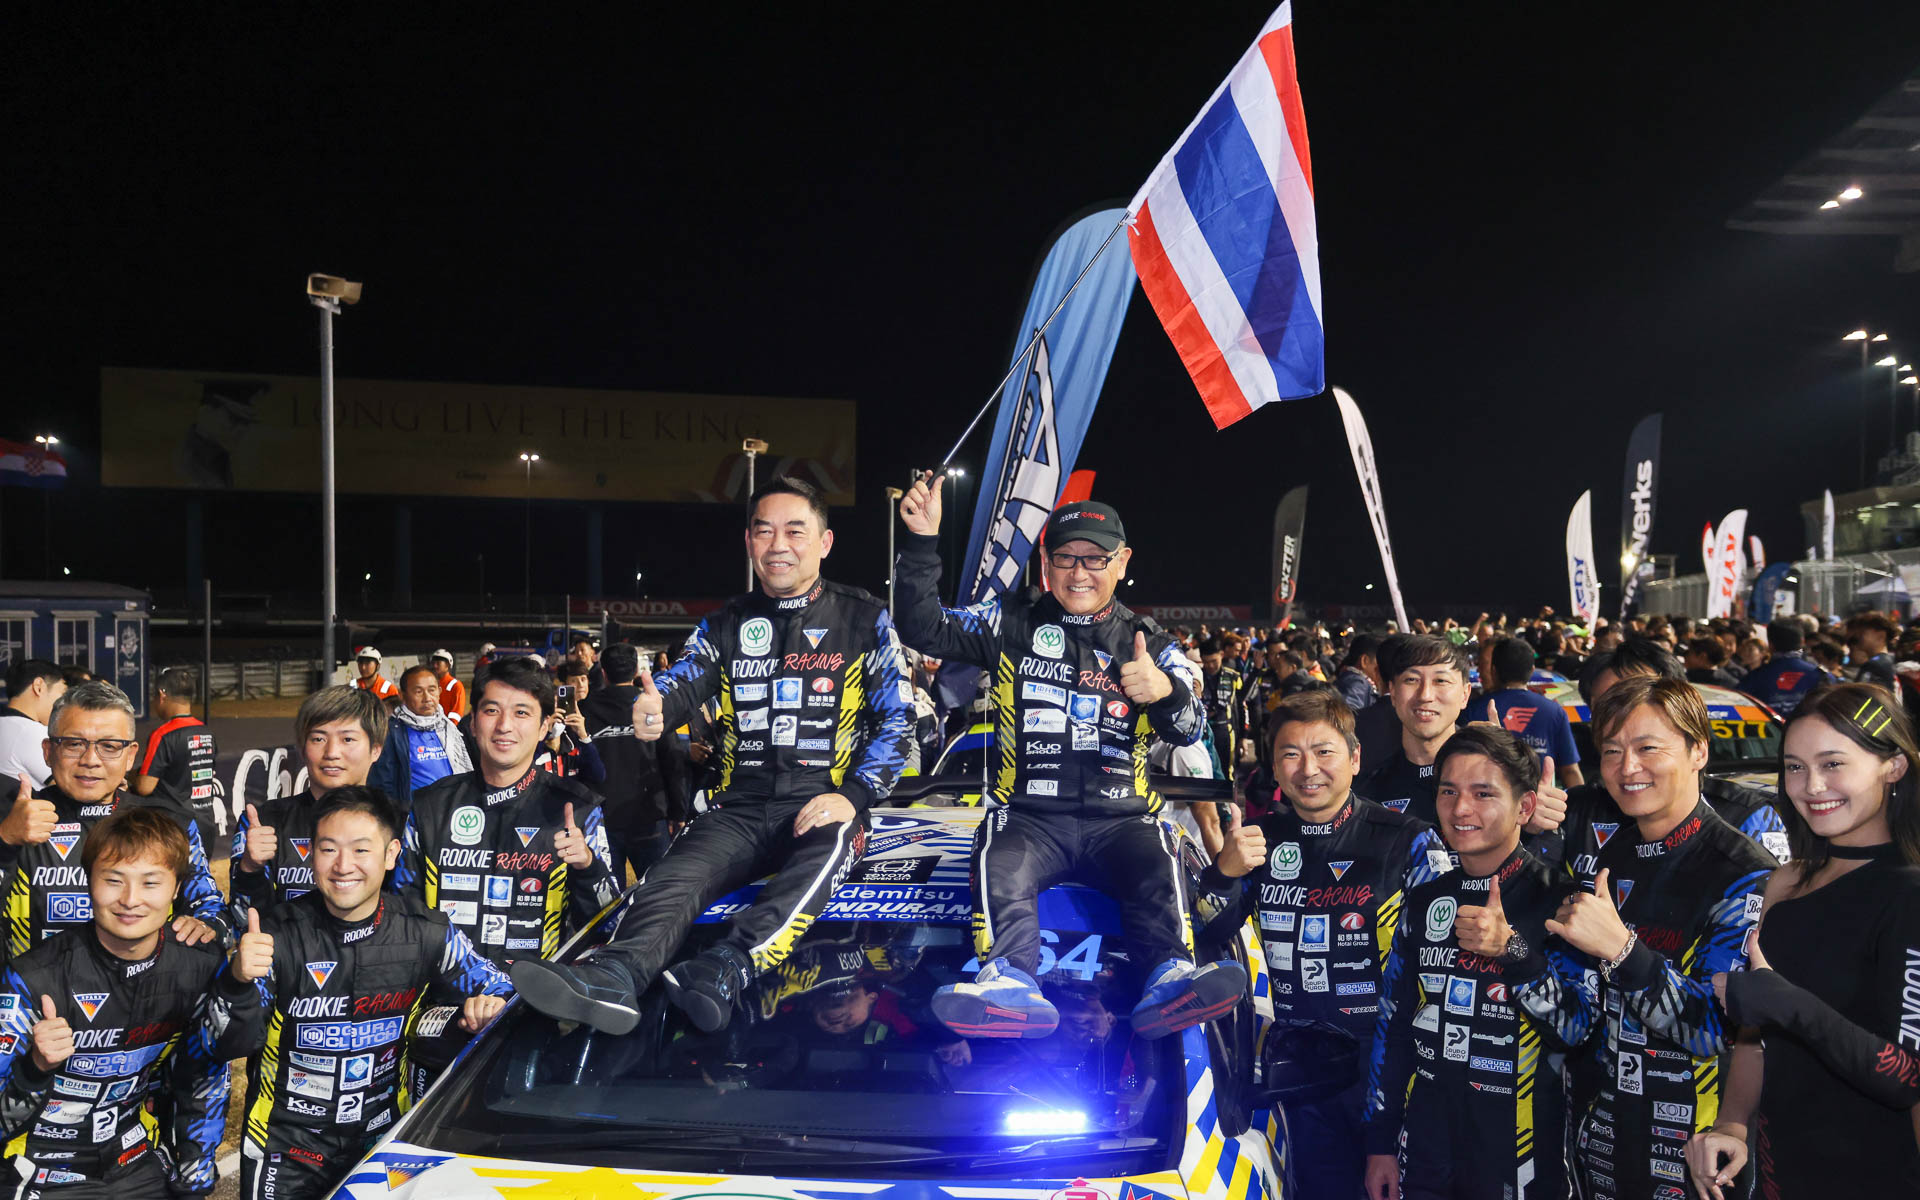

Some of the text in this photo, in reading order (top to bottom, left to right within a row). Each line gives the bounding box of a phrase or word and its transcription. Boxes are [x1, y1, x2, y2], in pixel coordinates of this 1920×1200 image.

[289, 392, 767, 445] LONG LIVE THE KING
[586, 600, 688, 616] HONDA
[1151, 606, 1235, 621] HONDA
[783, 652, 846, 672] RACING
[1018, 656, 1076, 683] ROOKIE
[1711, 720, 1767, 739] 577
[487, 785, 518, 806] ROOKIE
[81, 804, 113, 816] ROOKIE
[1301, 823, 1332, 835] ROOKIE
[1635, 817, 1702, 858] ROOKIE RACING
[439, 848, 554, 872] ROOKIE RACING
[1307, 884, 1374, 907] RACING
[823, 902, 972, 914] ENDURAN
[828, 912, 870, 920] ASIA
[344, 924, 375, 944] ROOKIE
[1419, 947, 1459, 968] ROOKIE
[288, 995, 350, 1018] ROOKIE
[326, 1020, 397, 1037] OGURA
[74, 1028, 124, 1049] OOKIE
[325, 1029, 397, 1048] CLUTCH
[1481, 1064, 1511, 1072] CLUTCH
[1482, 1059, 1511, 1067] OGURA
[417, 1068, 428, 1098] GAMO
[1482, 1085, 1512, 1094] YAZAKI
[1620, 1078, 1640, 1086] GRUPO
[1656, 1102, 1689, 1117] KOD
[288, 1147, 324, 1161] DENSO
[264, 1166, 278, 1200] DAISU
